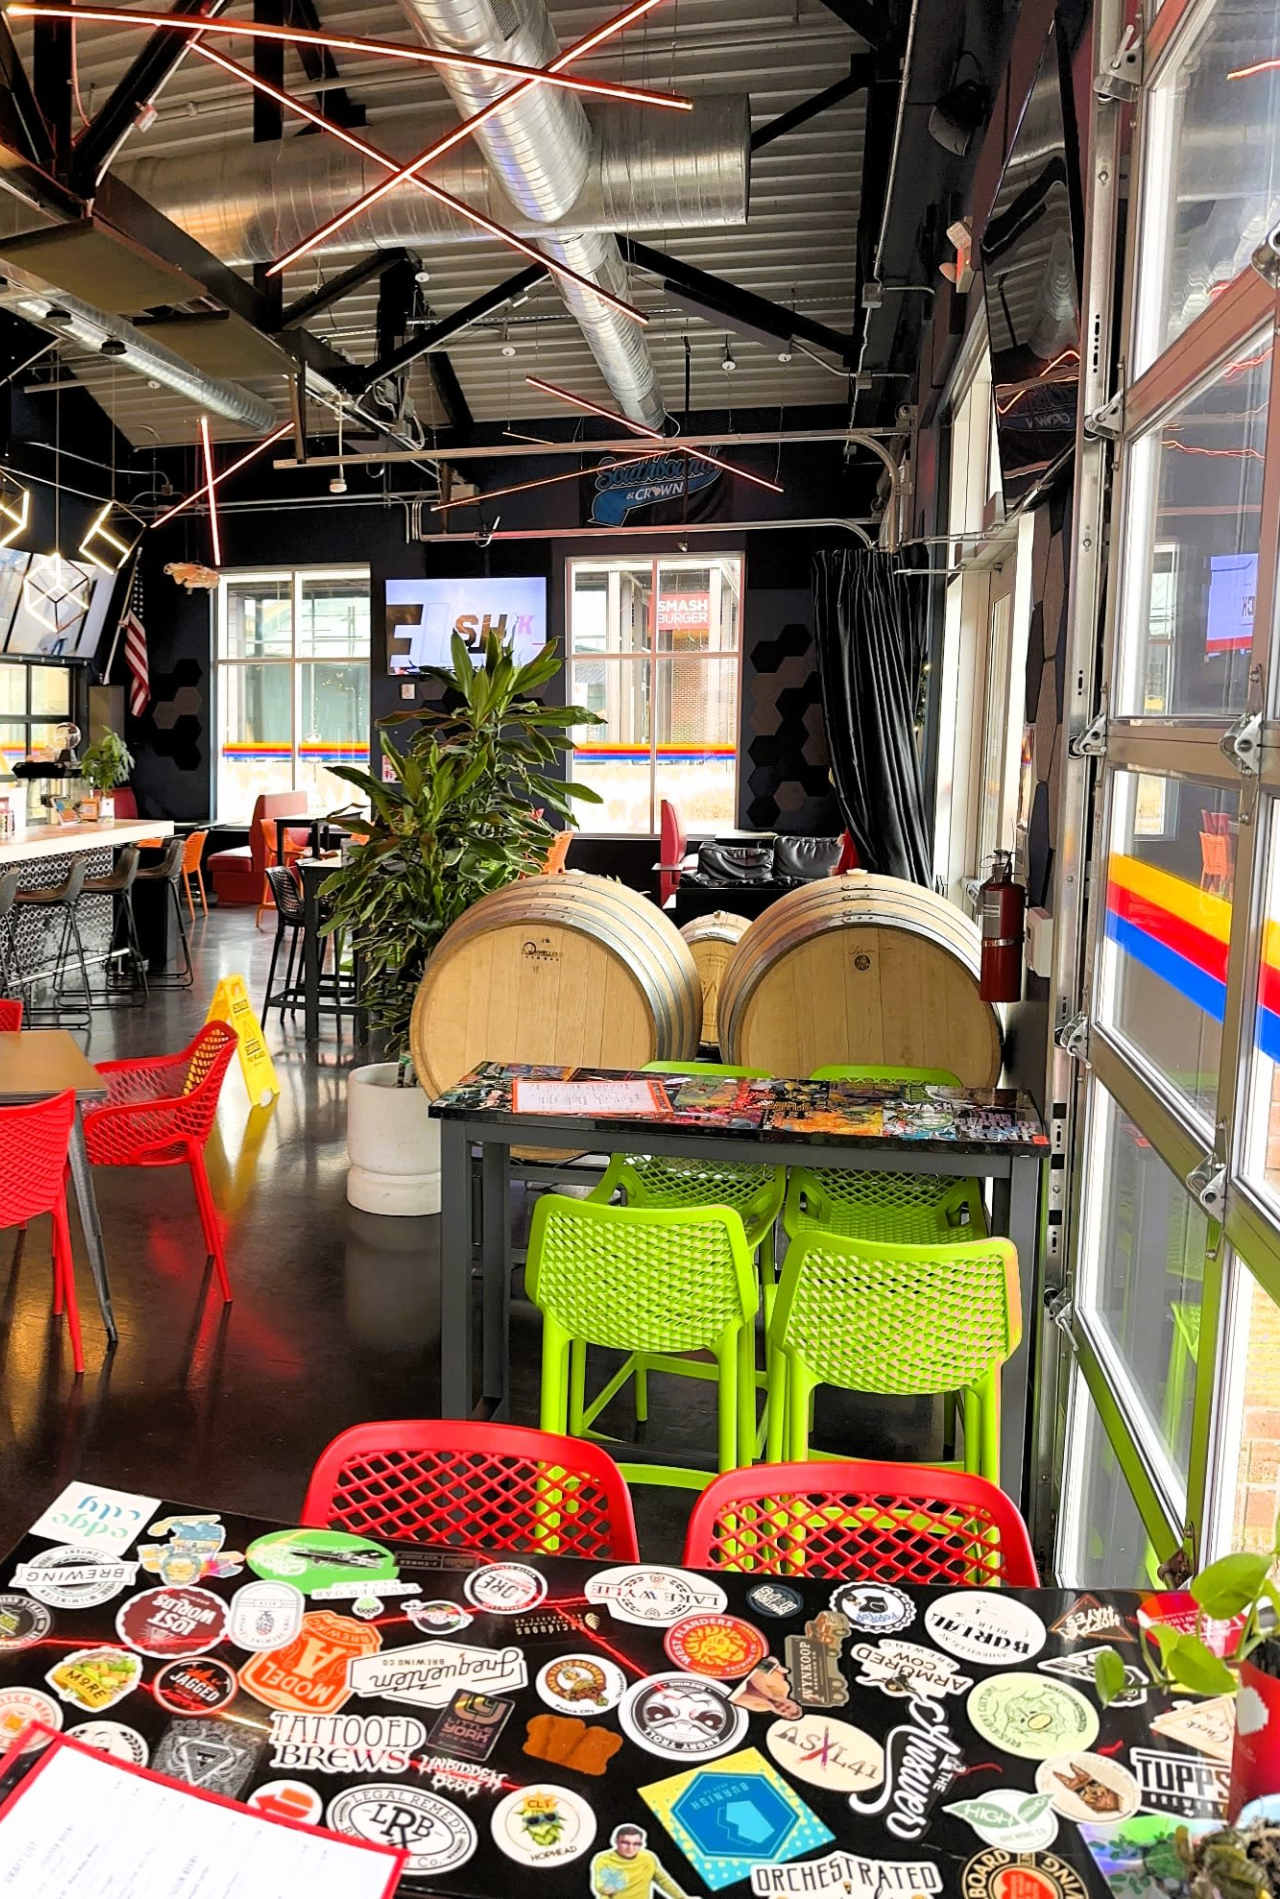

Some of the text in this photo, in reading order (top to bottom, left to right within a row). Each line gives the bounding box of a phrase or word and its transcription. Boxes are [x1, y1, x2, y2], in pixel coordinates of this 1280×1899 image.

[657, 600, 708, 613] SMASH
[51, 1512, 129, 1538] edge
[26, 1566, 126, 1582] BREWING
[591, 1583, 721, 1607] LAKE WYLIE
[151, 1593, 217, 1625] WORLDS
[147, 1610, 198, 1636] LOST
[932, 1611, 1031, 1655] BURIAL
[670, 1617, 734, 1665] WEST FLANDERS
[293, 1637, 347, 1679] A
[398, 1657, 446, 1667] BREWING
[799, 1641, 813, 1700] WYNKOOP
[893, 1651, 938, 1671] COW
[66, 1669, 107, 1700] MORE
[169, 1672, 221, 1703] JAGGED
[260, 1660, 336, 1704] MODEL
[274, 1713, 423, 1746] TATTOOED
[440, 1722, 490, 1743] YORK
[643, 1726, 722, 1752] ANGRY TROLL
[278, 1744, 406, 1771] BREWS
[933, 1770, 954, 1792] THE
[1140, 1759, 1231, 1799] TUPPS
[351, 1789, 467, 1837] LEGAL REMEDY
[527, 1799, 551, 1810] CLT
[964, 1802, 1017, 1827] HIGH
[529, 1845, 578, 1863] HOPHEAD
[756, 1855, 938, 1893] ORCHESTRATED
[968, 1848, 1011, 1899] BOARD
